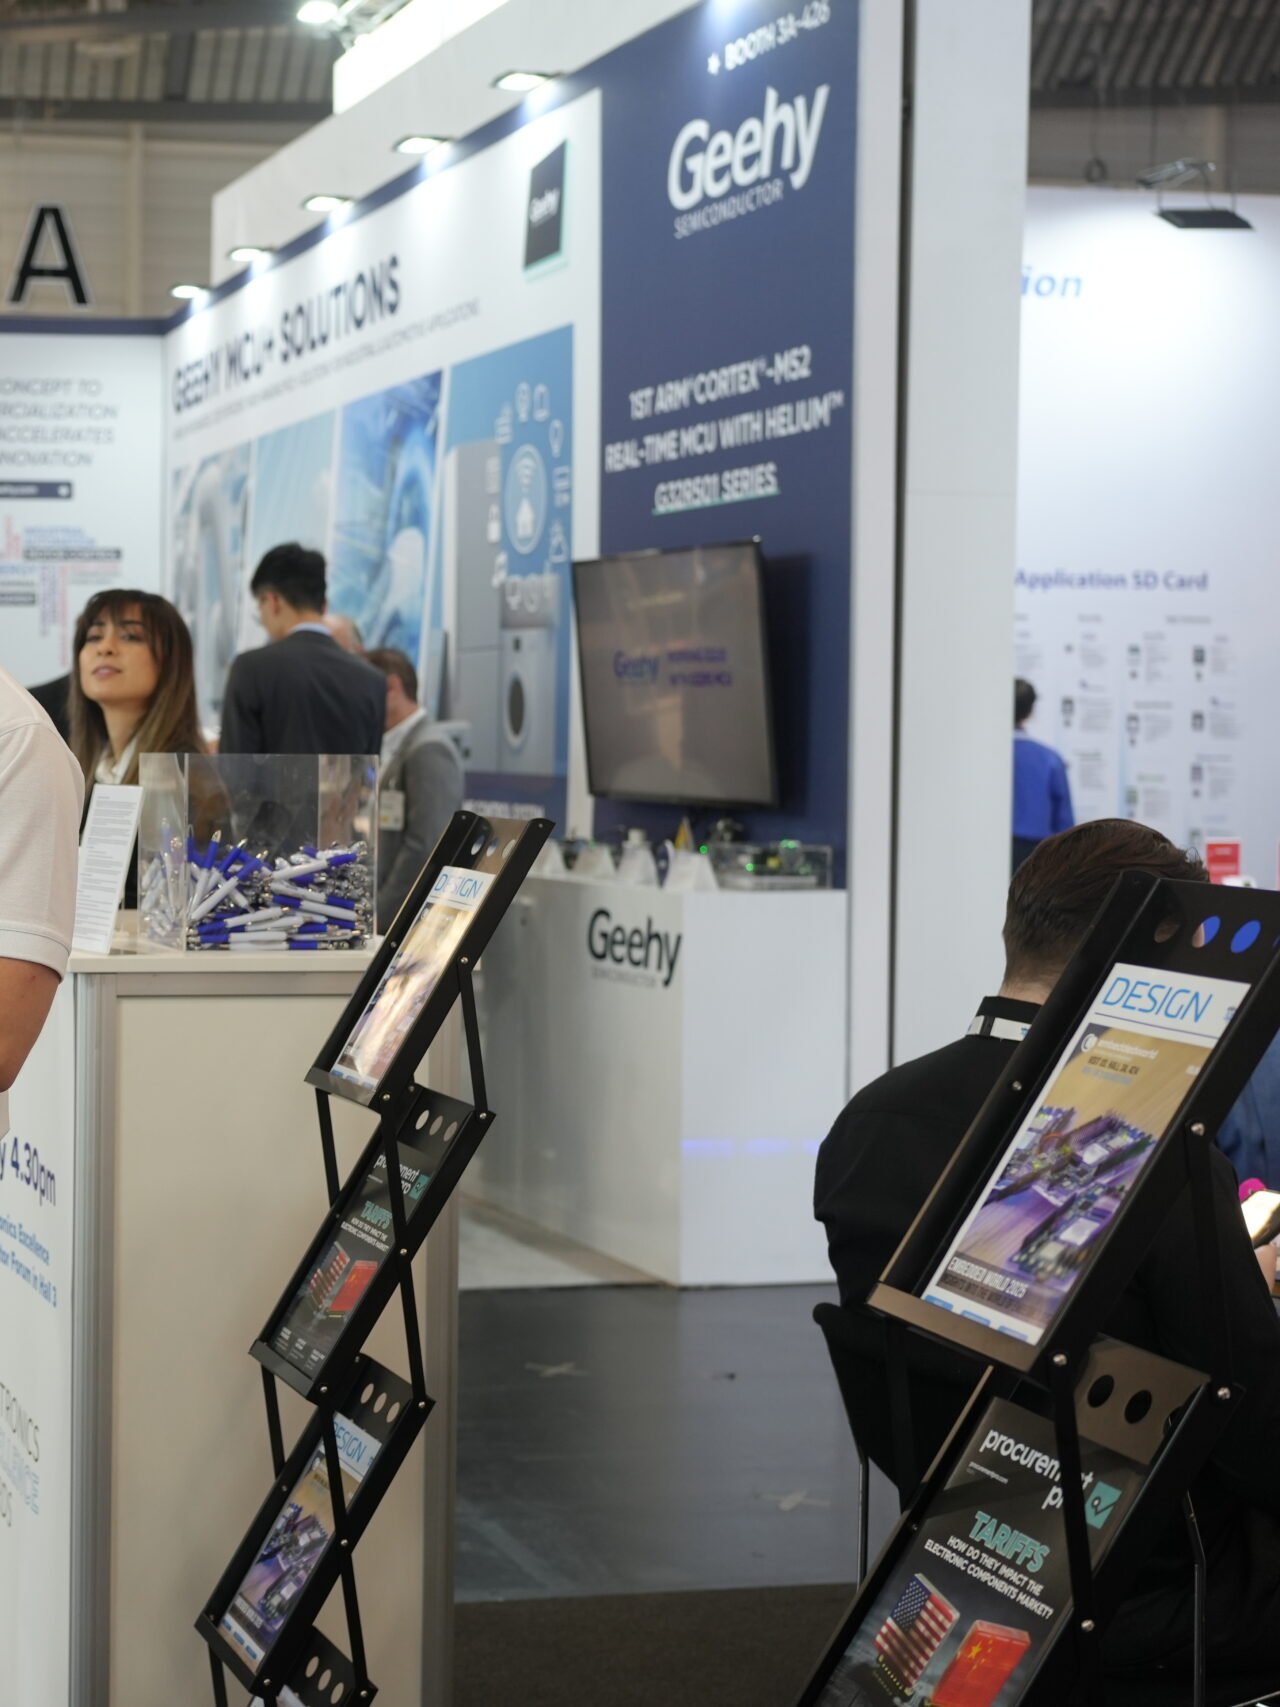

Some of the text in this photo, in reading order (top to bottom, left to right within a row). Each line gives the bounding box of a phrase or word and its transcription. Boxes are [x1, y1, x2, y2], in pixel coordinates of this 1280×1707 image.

[667, 83, 830, 211] Geehy
[673, 178, 784, 240] SEMICONDUCTOR
[279, 254, 401, 363] SOLUTIONS
[680, 419, 718, 458] MCU
[718, 410, 764, 450] WITH
[721, 461, 778, 502] SERIES
[1163, 571, 1209, 590] Card
[587, 908, 682, 988] Geehy
[1102, 977, 1213, 1023] DESIGN
[10, 1136, 57, 1206] 4.30pm
[947, 1536, 1044, 1596] HOW DO THEY IMPACT THE
[969, 1510, 1050, 1573] TARIFFS
[924, 1538, 1054, 1620] ELECTRONIC COMPONENTS MARKET?
